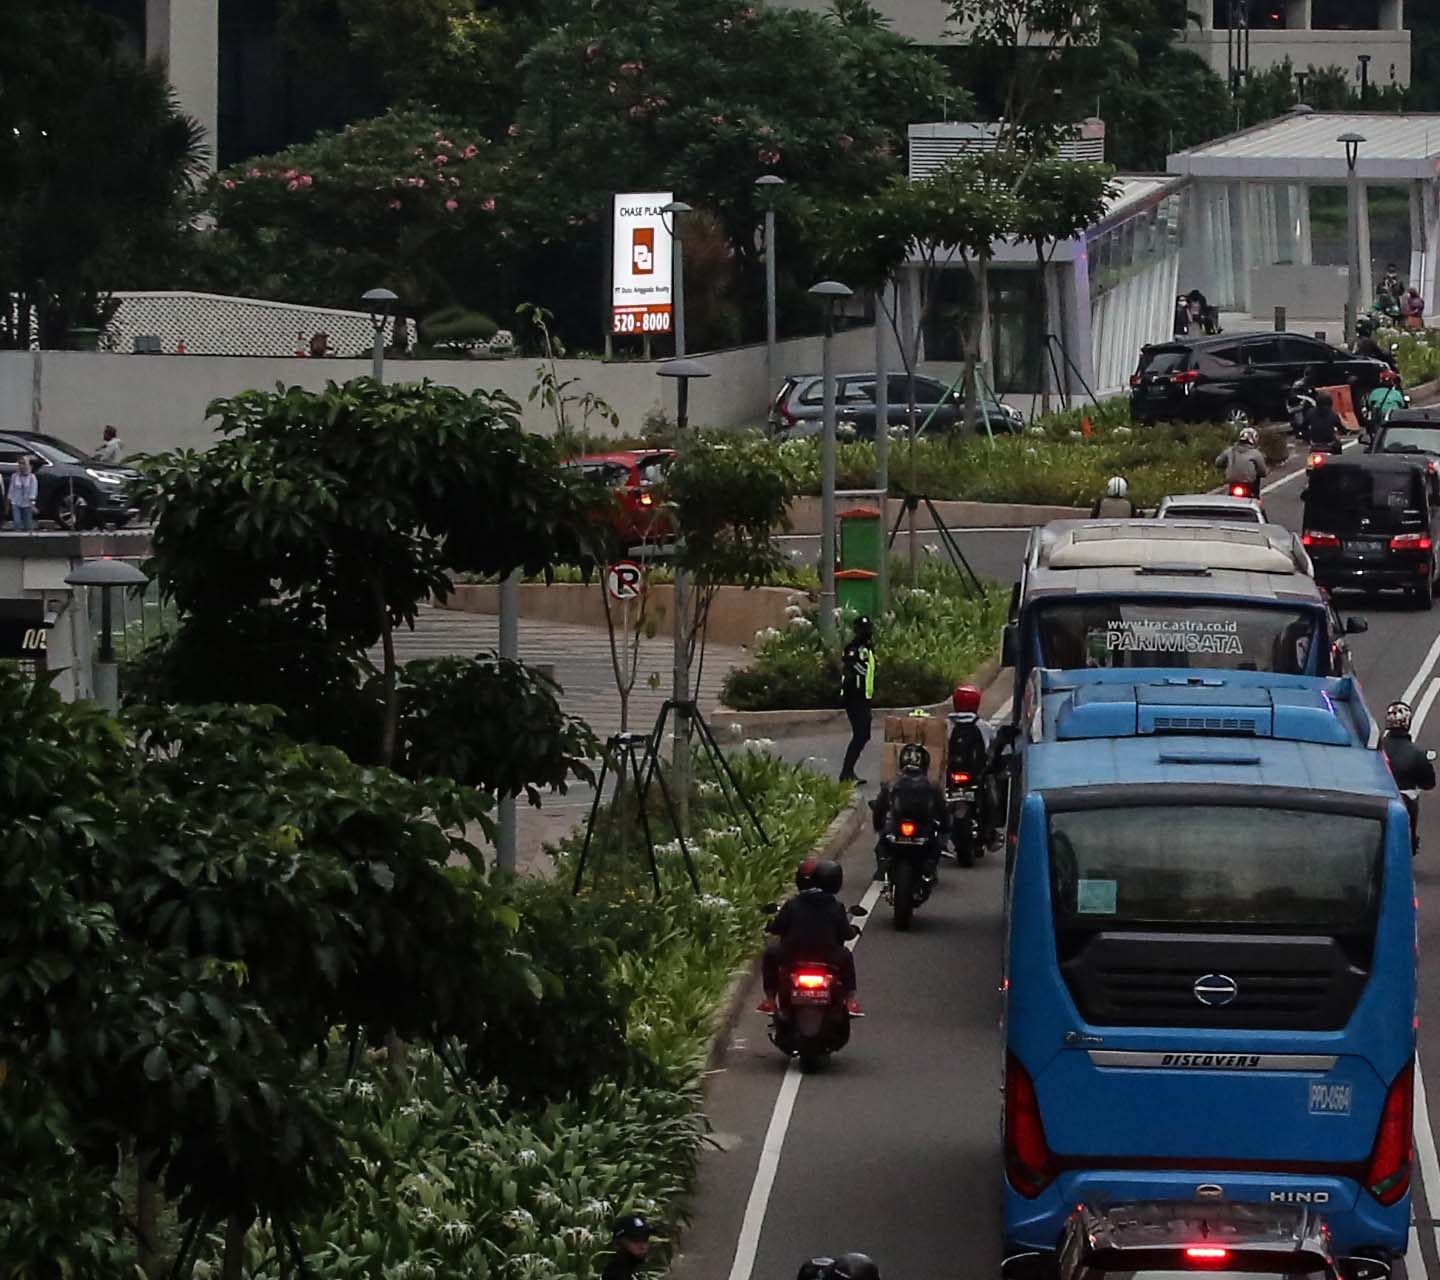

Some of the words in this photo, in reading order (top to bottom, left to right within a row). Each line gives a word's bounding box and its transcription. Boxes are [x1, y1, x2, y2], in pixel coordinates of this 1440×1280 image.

[619, 207, 643, 218] CHASE
[1107, 618, 1238, 632] www.trac.astra.co.id
[1106, 631, 1243, 654] PARIWISATA
[1161, 1054, 1261, 1067] DISCOVERY
[1270, 1191, 1329, 1203] HINO
